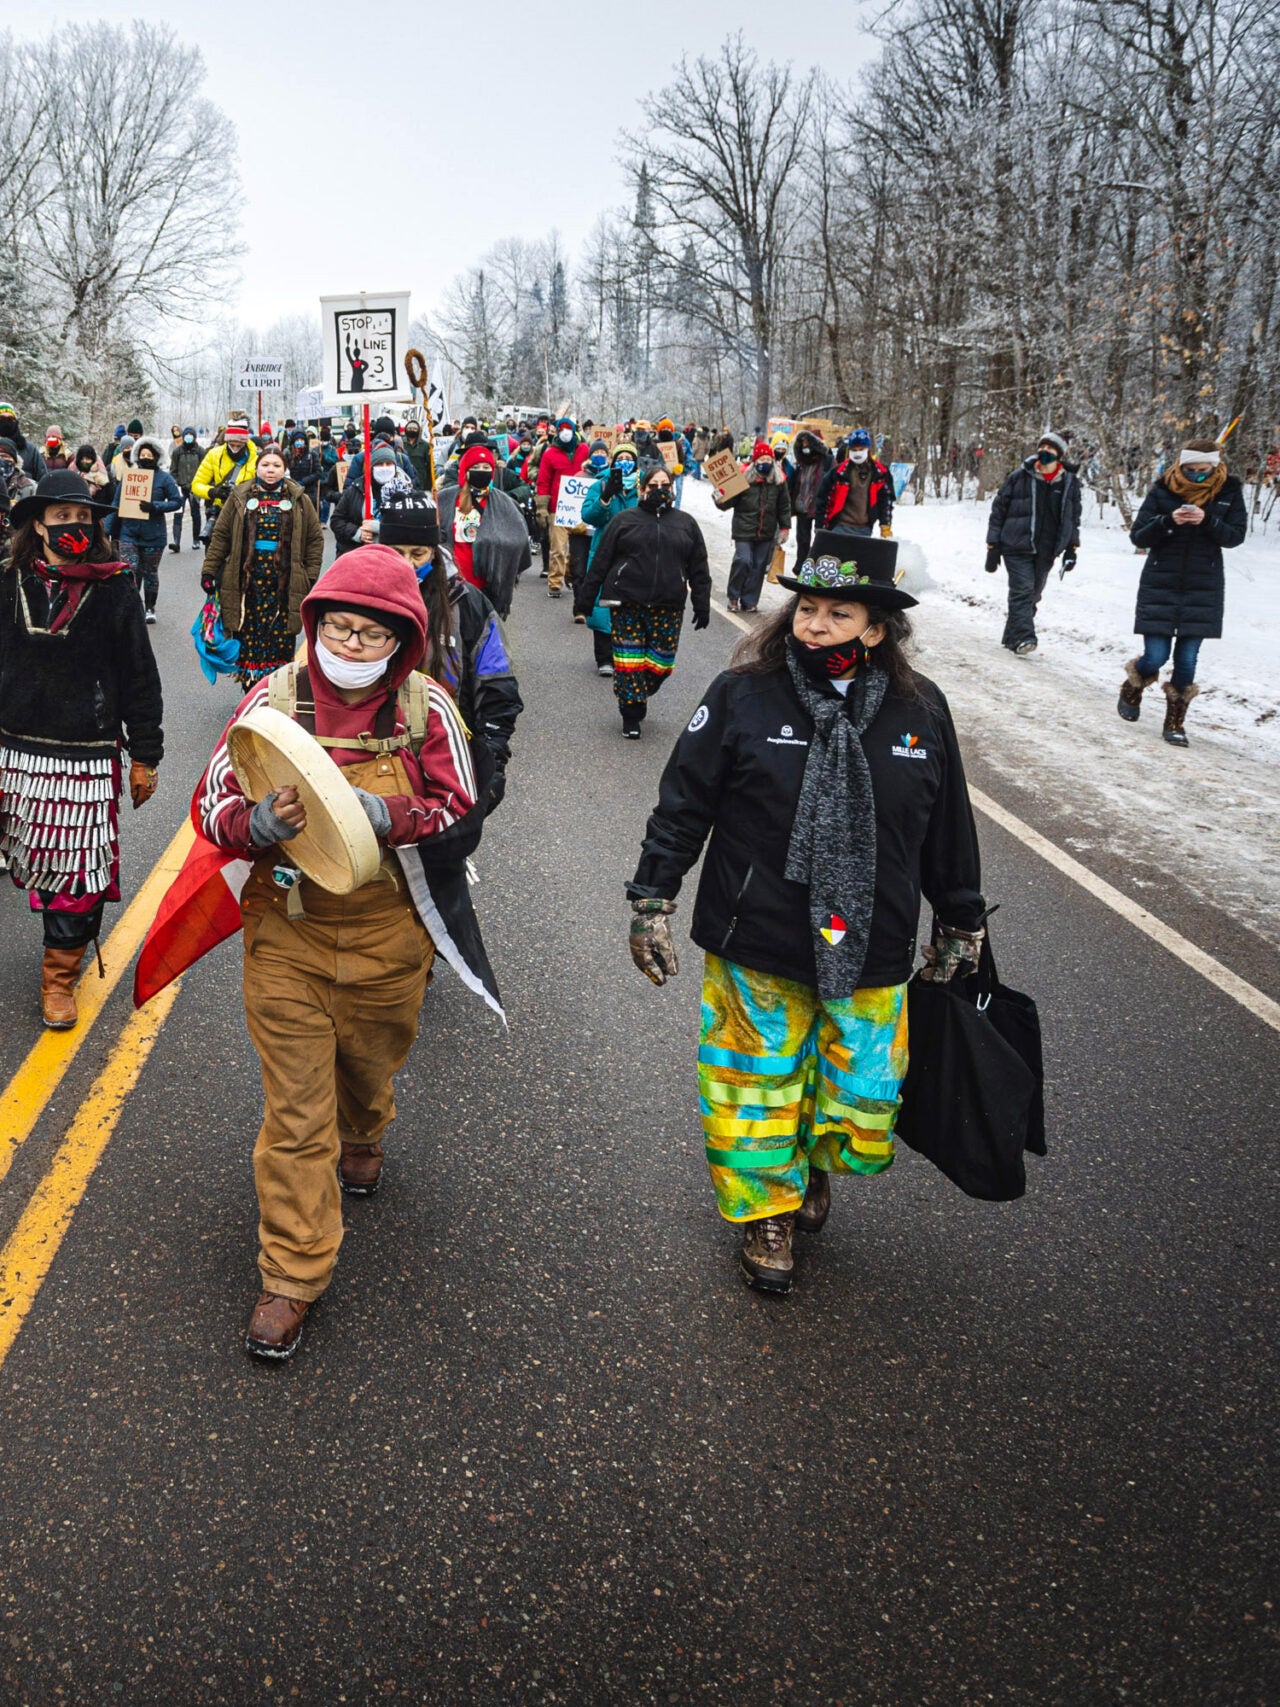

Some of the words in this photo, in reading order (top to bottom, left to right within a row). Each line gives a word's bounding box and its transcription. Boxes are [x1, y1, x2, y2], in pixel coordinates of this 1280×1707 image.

[341, 315, 372, 331] STOP
[363, 338, 387, 350] LINE
[373, 355, 384, 374] 3
[240, 378, 281, 388] CULPRIT
[708, 455, 729, 472] STOP
[127, 473, 149, 483] STOP
[125, 485, 141, 497] LINE
[143, 486, 148, 497] 3
[564, 478, 589, 496] Sto
